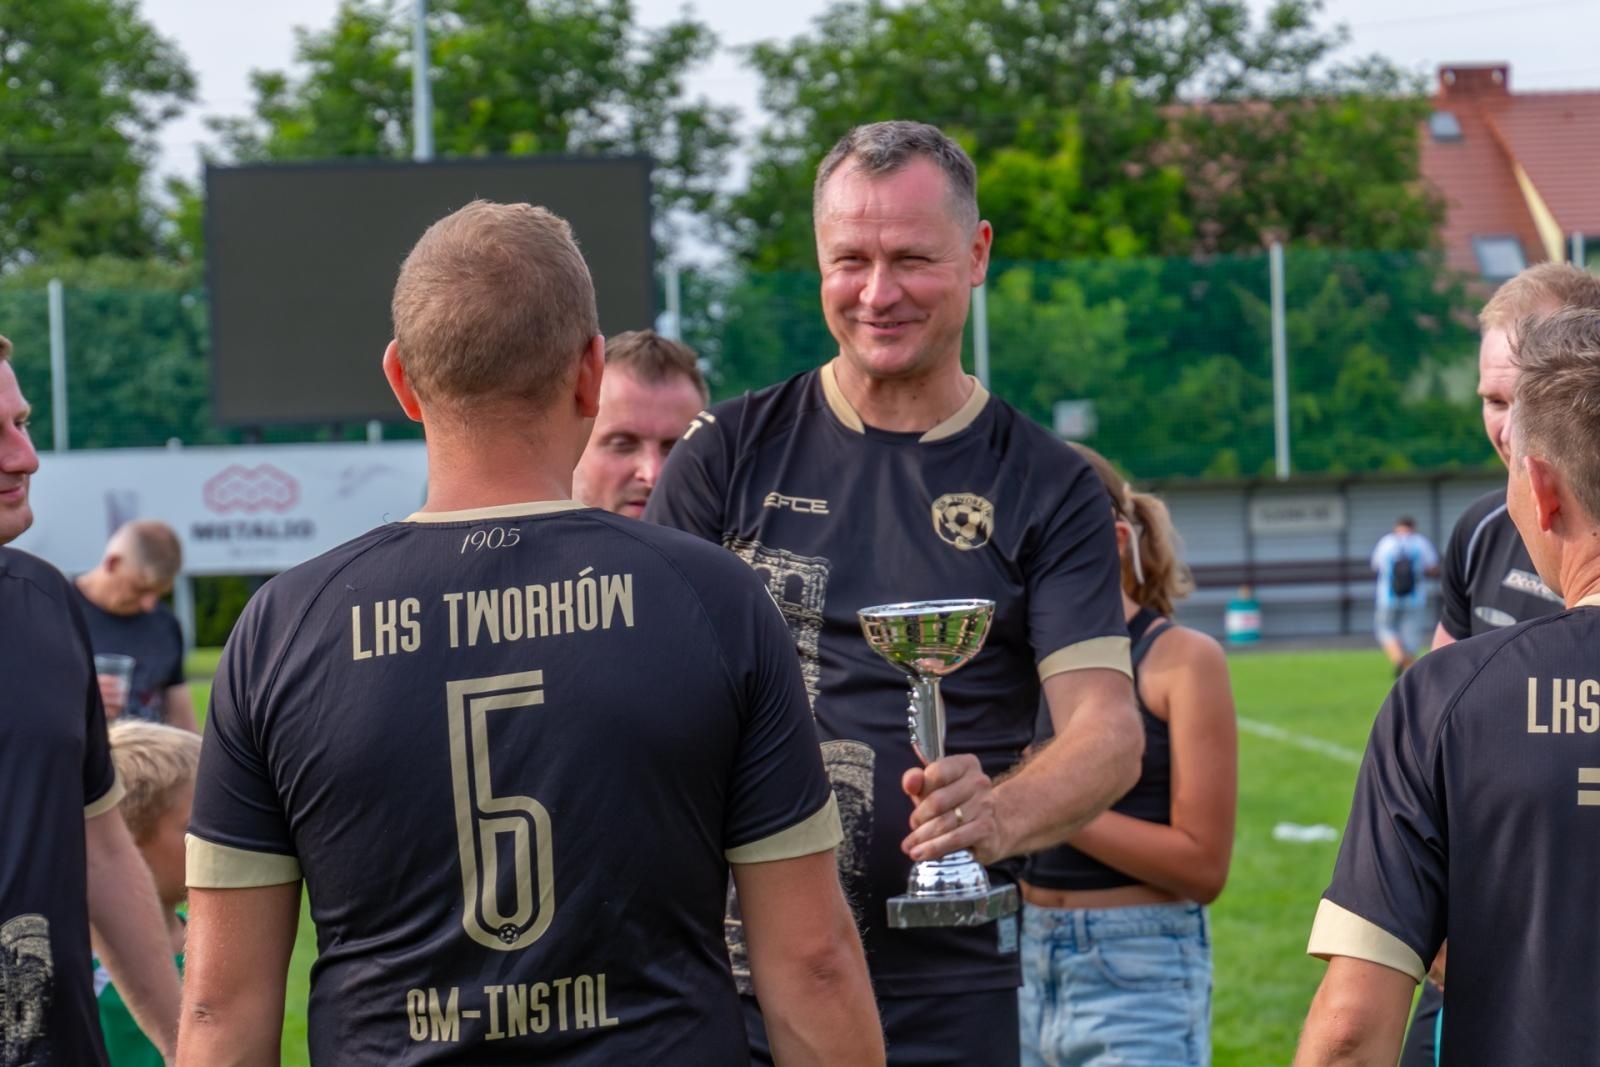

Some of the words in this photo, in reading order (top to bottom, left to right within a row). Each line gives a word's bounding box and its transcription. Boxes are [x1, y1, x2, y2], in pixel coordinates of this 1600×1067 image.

[461, 526, 521, 554] 1905
[352, 597, 422, 661] LKS
[443, 566, 635, 648] TWORKÓW
[1527, 677, 1600, 734] LKS
[446, 669, 555, 951] 6
[406, 973, 620, 1042] GM-INSTAL
